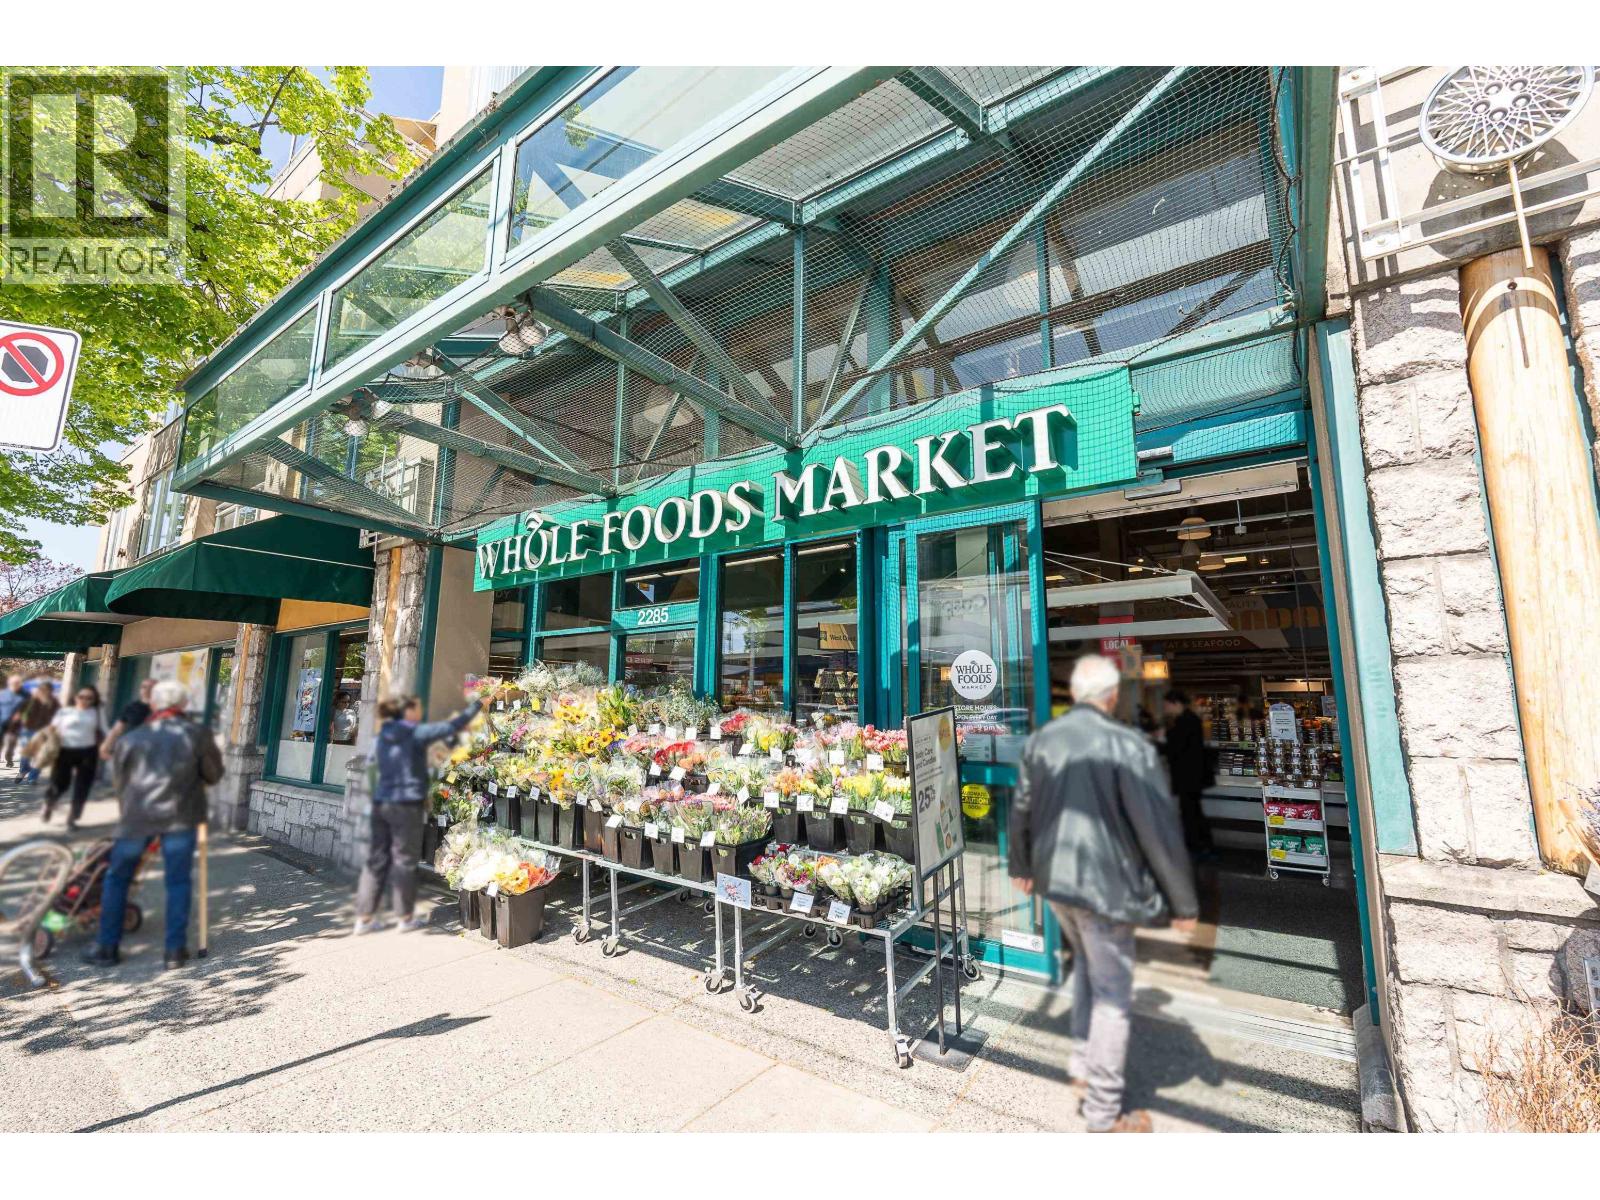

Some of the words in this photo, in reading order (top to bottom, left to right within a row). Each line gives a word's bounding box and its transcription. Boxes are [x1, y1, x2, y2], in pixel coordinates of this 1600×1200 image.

[476, 514, 589, 579] WHOLE
[600, 482, 752, 556] FOODS
[772, 404, 1070, 522] MARKET
[638, 607, 668, 626] 2285
[1192, 639, 1241, 649] SEAFOOD
[955, 660, 992, 674] WHOLE
[958, 674, 992, 684] FOODS
